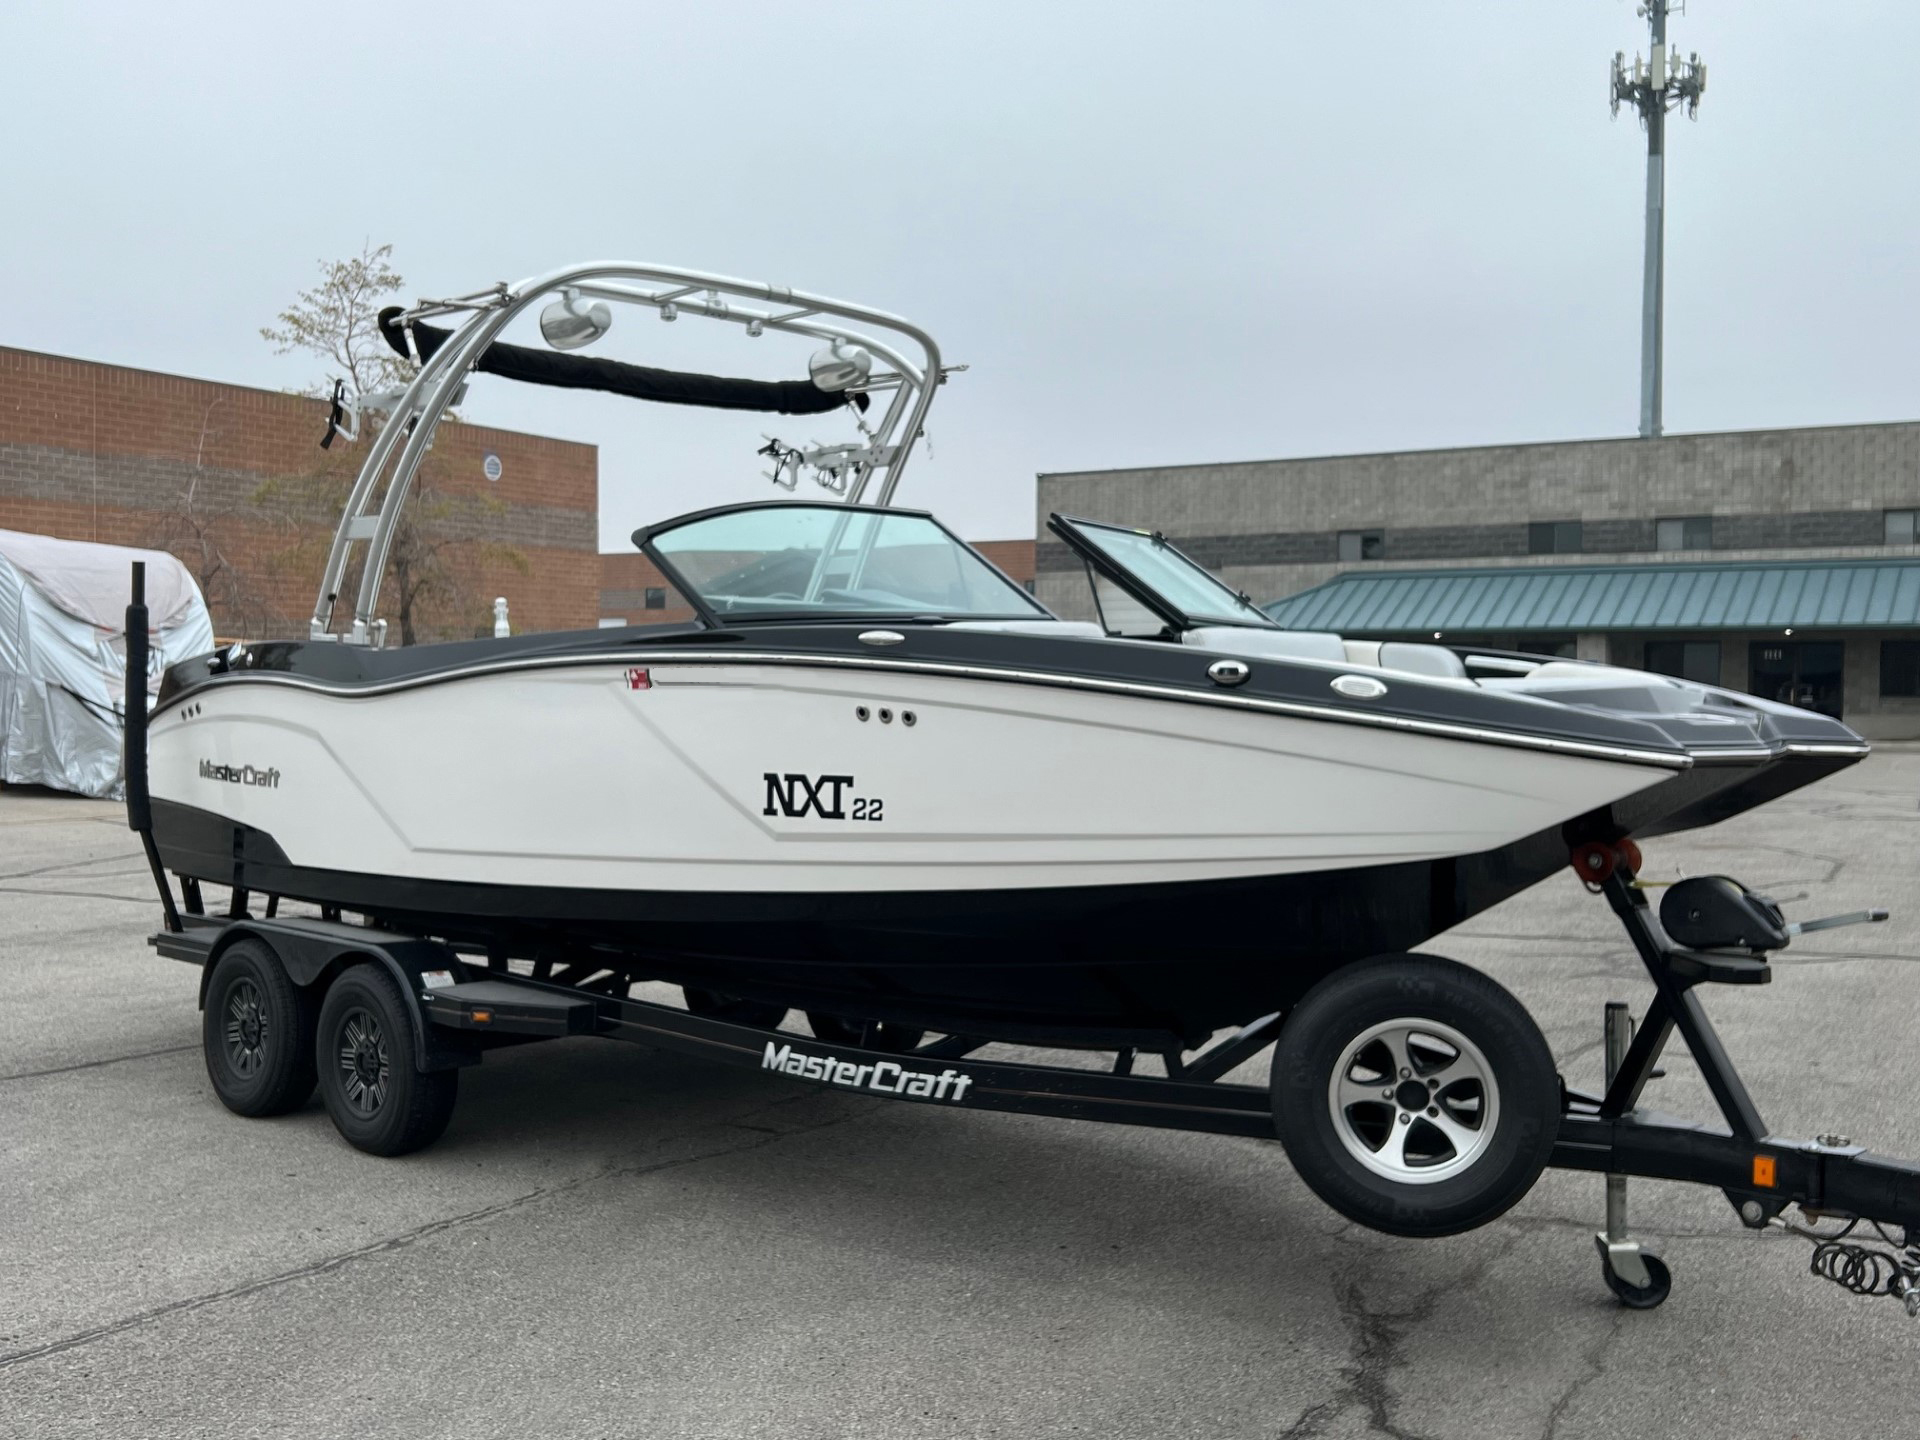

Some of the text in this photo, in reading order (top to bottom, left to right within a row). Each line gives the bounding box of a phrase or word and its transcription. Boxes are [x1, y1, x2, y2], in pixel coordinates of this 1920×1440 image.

[199, 758, 281, 789] MasterCraft
[763, 772, 883, 821] NXT 22
[761, 1041, 972, 1101] MasterCraft
